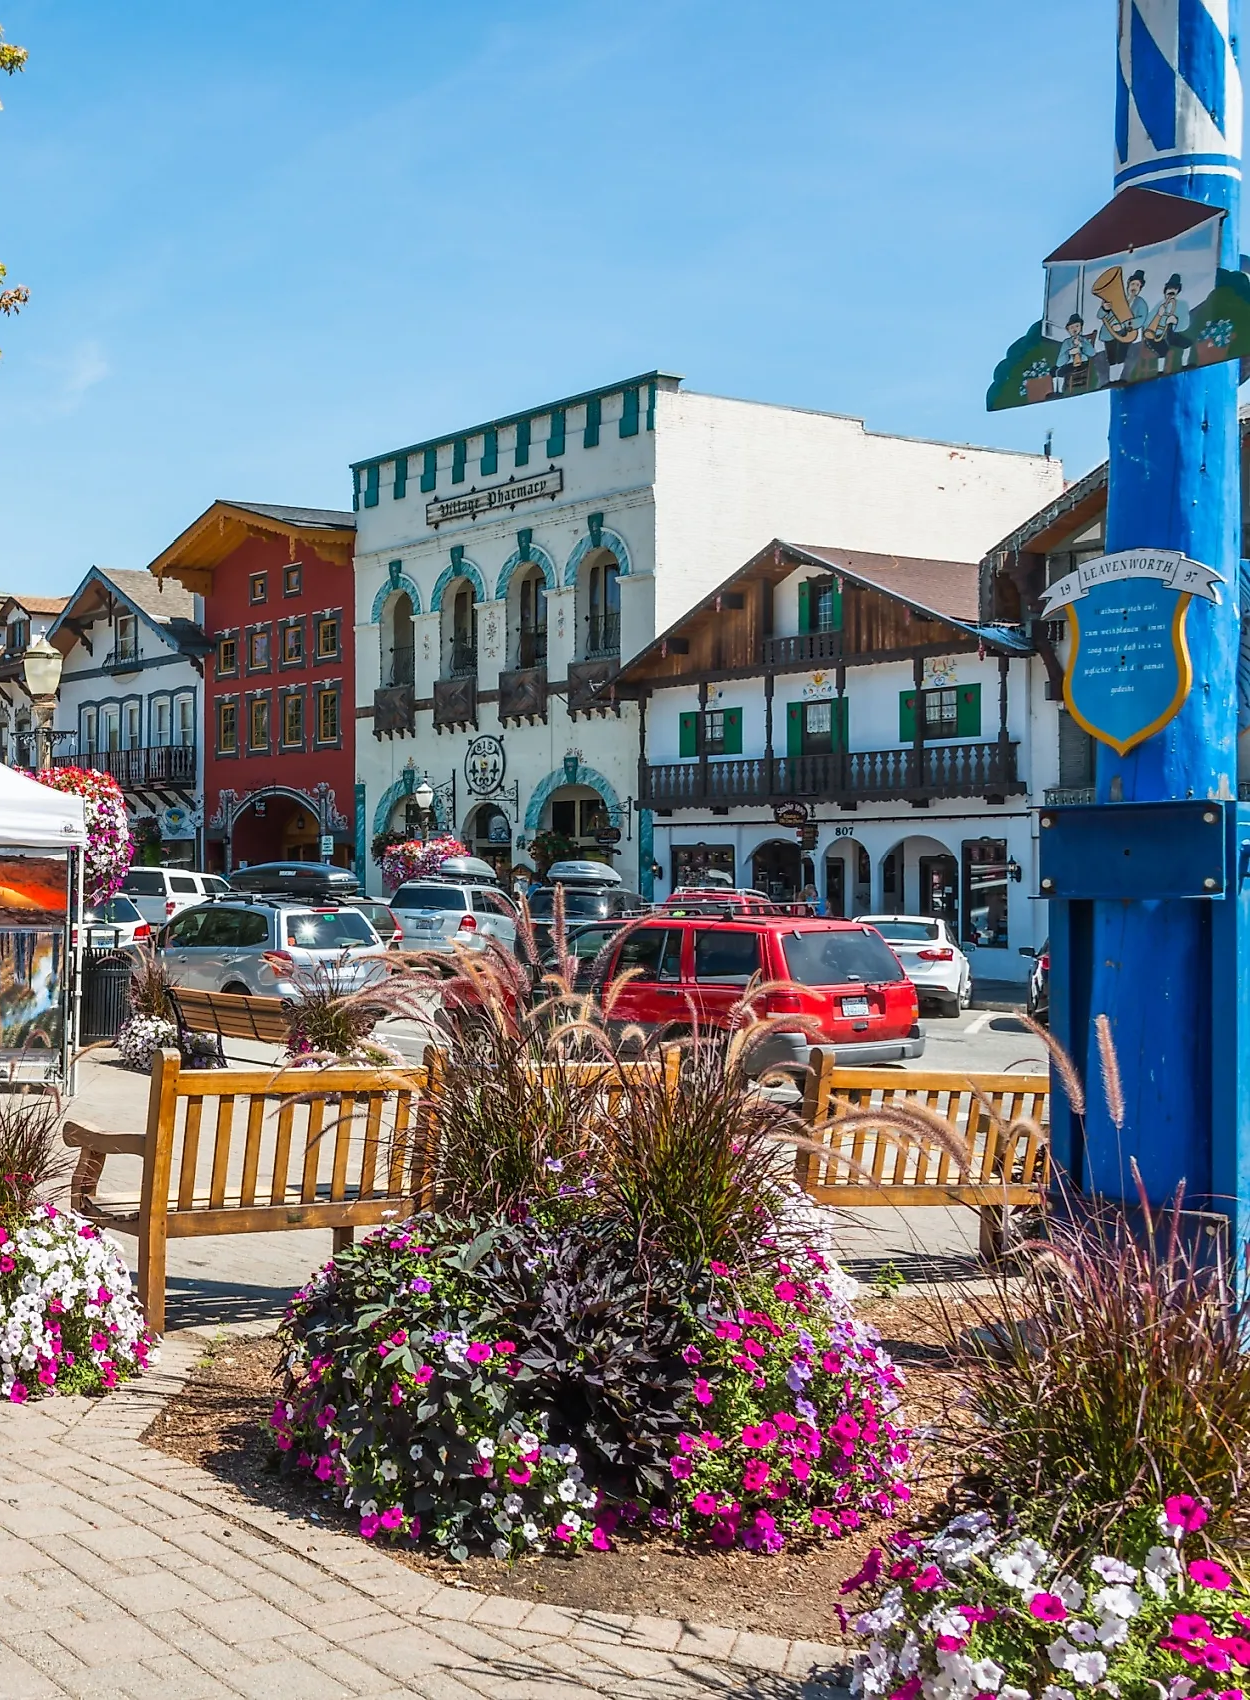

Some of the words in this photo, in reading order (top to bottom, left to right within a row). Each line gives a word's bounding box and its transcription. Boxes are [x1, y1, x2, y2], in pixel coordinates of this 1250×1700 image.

[439, 499, 479, 517] Village
[487, 480, 547, 508] Pharmacy
[1059, 583, 1071, 597] 19
[1083, 557, 1174, 582] LEAVENWORTH
[1183, 571, 1199, 583] 97
[476, 740, 493, 752] 815
[835, 827, 854, 836] 807
